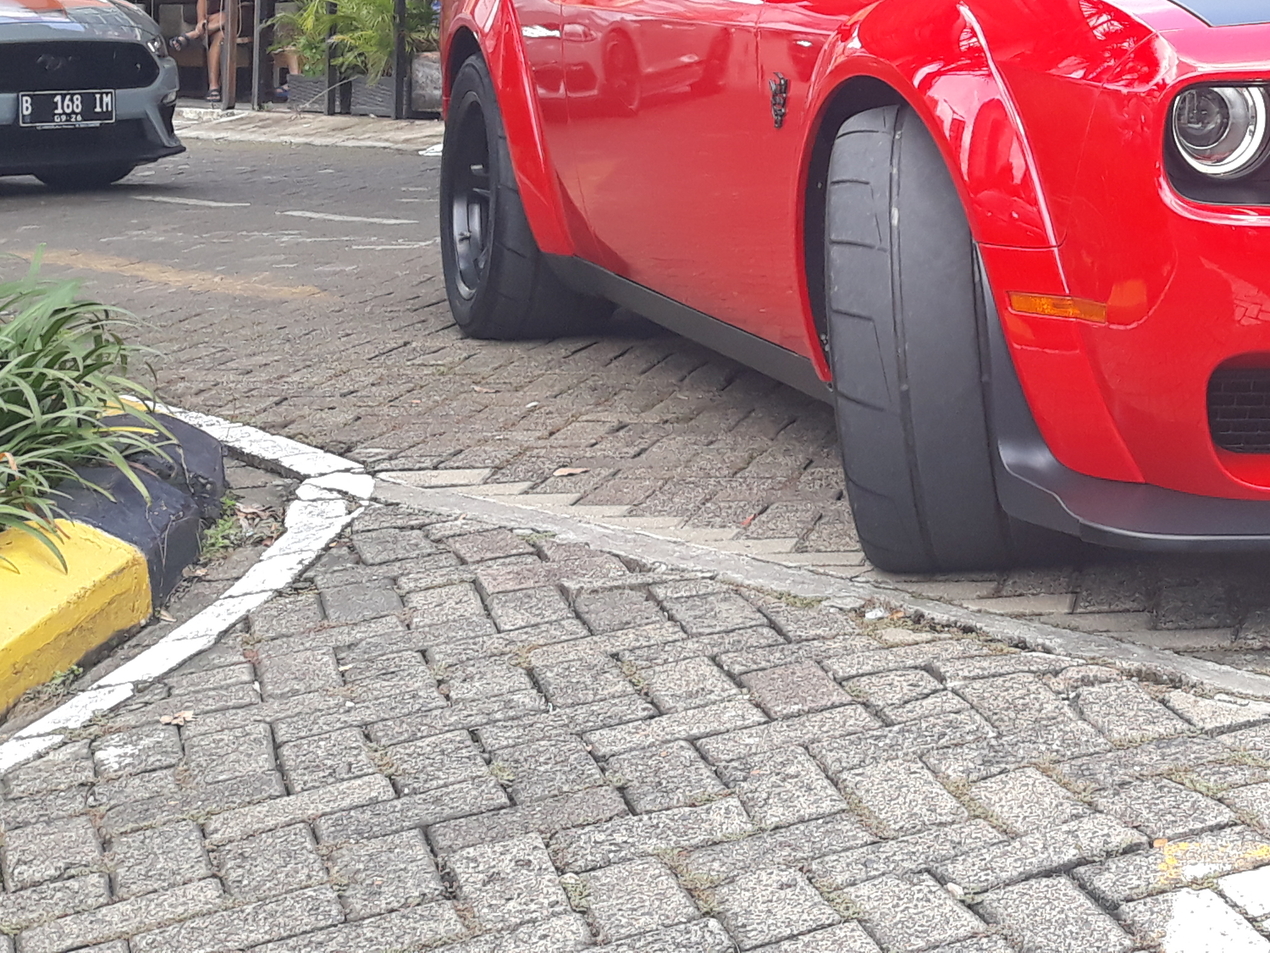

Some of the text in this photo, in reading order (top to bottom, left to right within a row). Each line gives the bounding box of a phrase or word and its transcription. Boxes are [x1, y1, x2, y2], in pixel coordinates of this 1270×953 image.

[22, 93, 112, 115] B 168 IM
